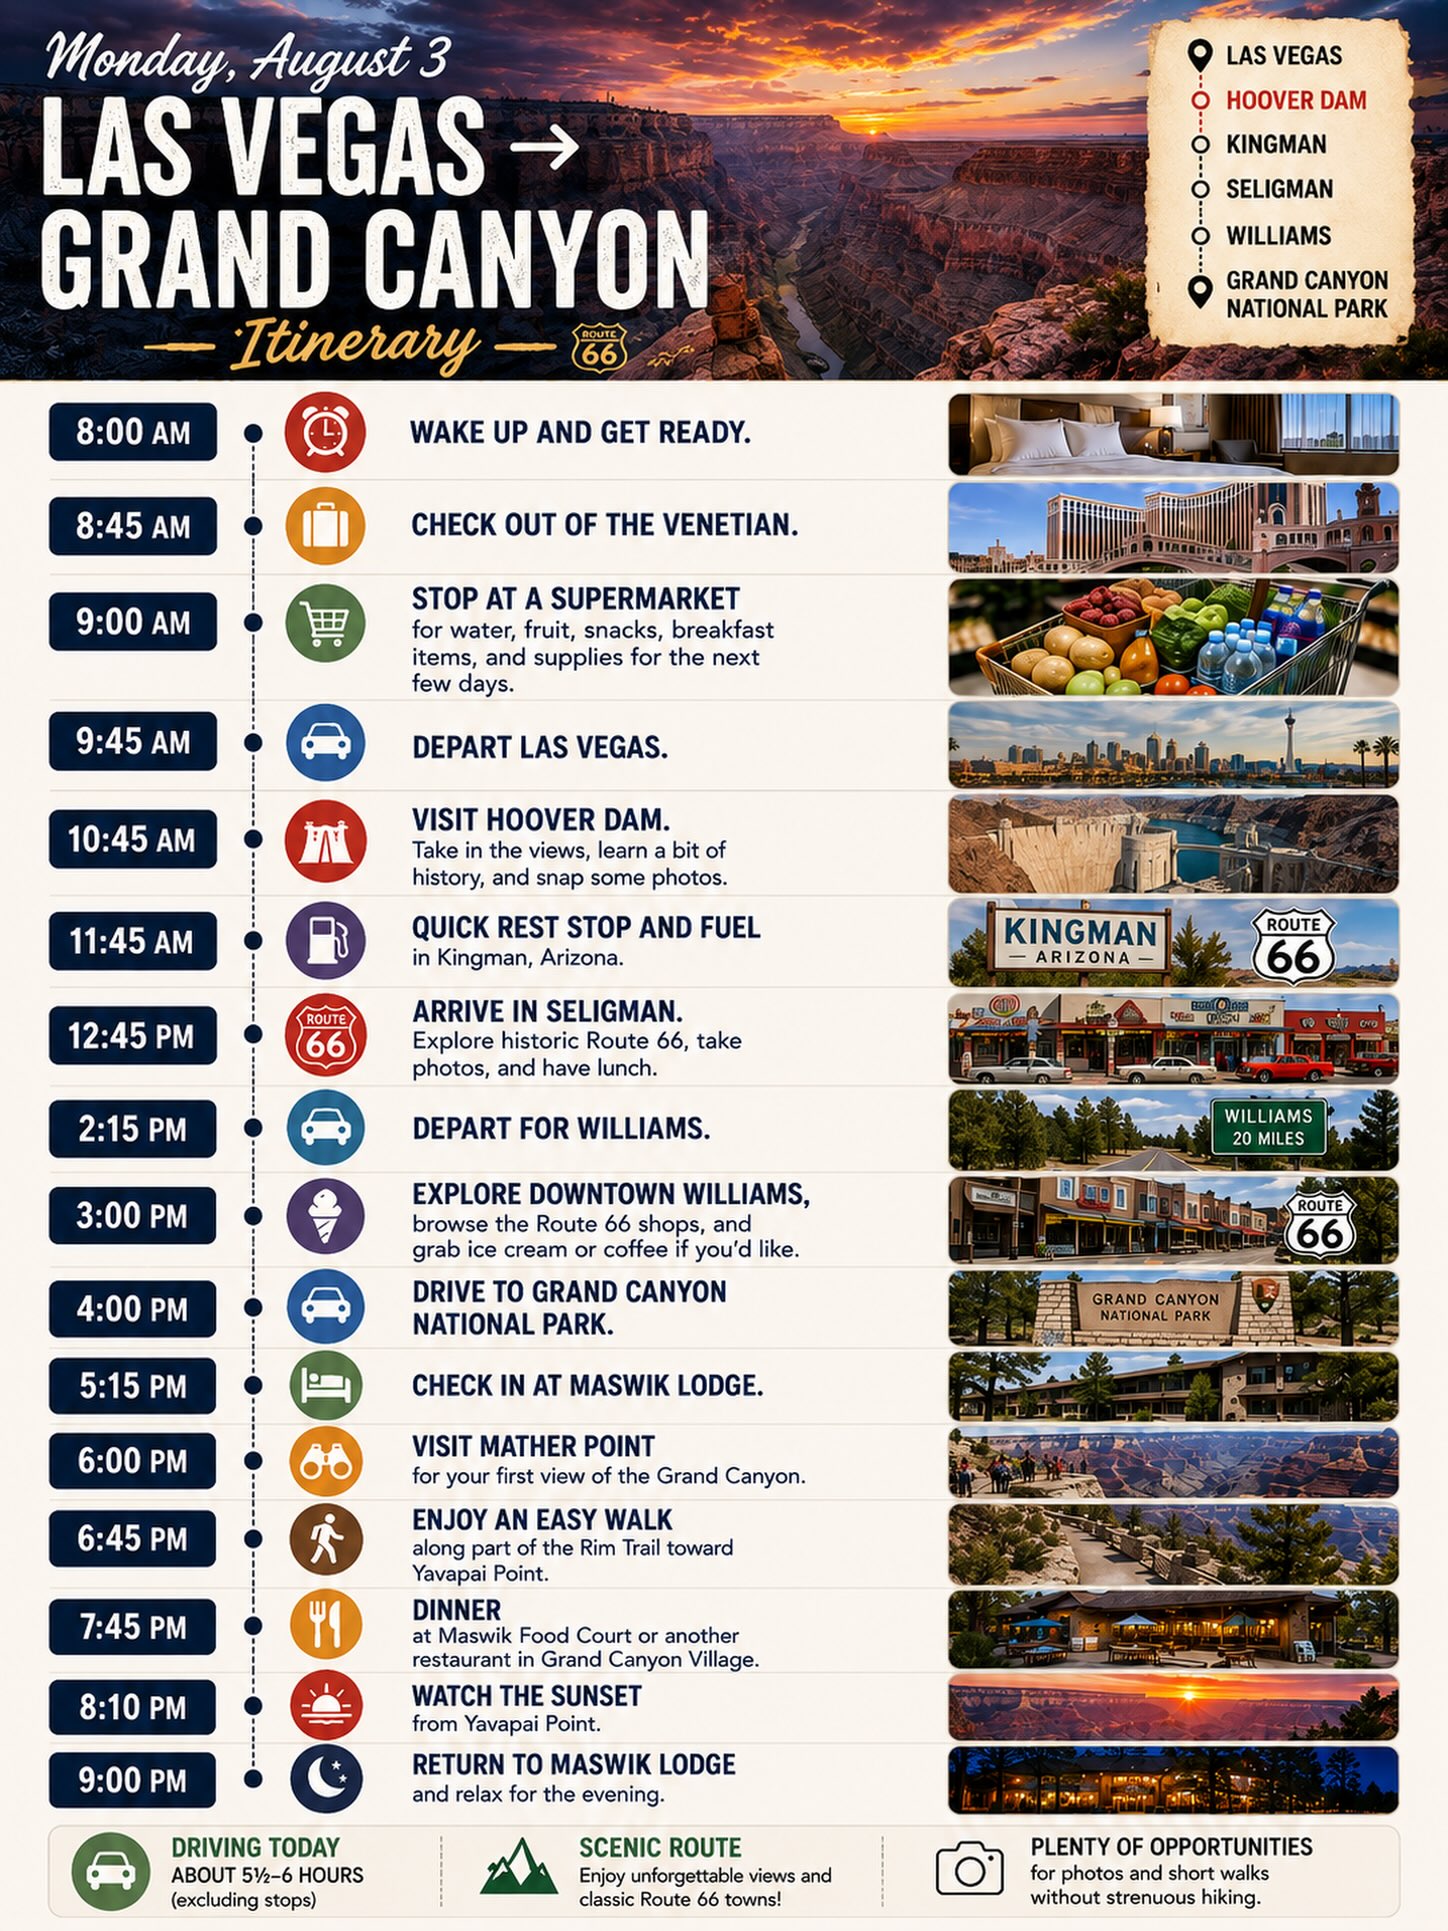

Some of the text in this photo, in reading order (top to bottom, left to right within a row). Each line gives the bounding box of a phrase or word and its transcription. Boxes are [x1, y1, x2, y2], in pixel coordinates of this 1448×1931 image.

[45, 29, 452, 94] Monday, August 3
[1227, 45, 1343, 66] LAS VEGAS
[1227, 89, 1367, 111] HOOVER DAM
[43, 95, 485, 197] LAS VEGAS
[1227, 133, 1327, 154] KINGMAN
[1226, 178, 1333, 199] SELIGMAN
[1226, 225, 1332, 246] WILLIAMS
[41, 208, 709, 311] GRAND CANYON
[1226, 270, 1389, 290] GRAND CANYON
[1227, 298, 1389, 319] NATIONAL PARK
[581, 330, 618, 339] ROUTE
[230, 316, 482, 378] Itinerary
[581, 342, 618, 366] 66
[76, 416, 190, 446] 8:00 AM
[409, 419, 751, 444] WAKE UP AND GET READY.
[411, 511, 798, 537] CHECK OUT OF THE VENETIAN.
[412, 586, 741, 611] STOP AT A SUPERMARKET
[76, 606, 190, 636] 9:00 AM
[411, 618, 775, 642] for water, fruit, snacks, breakfast
[411, 672, 514, 698] few days.
[412, 807, 670, 832] VISIT HOOVER DAM.
[68, 824, 195, 853] 10:45 AM
[413, 867, 728, 891] history, and snap some photos.
[412, 915, 761, 942] QUICK REST STOP AND FUEL
[1004, 917, 1157, 947] KINGMAN
[1267, 917, 1321, 932] ROUTE
[413, 947, 624, 971] in Kingman, Arizona.
[1035, 950, 1130, 965] ARIZONA
[1266, 937, 1322, 975] 66
[306, 1013, 347, 1025] ROUTE
[412, 999, 683, 1023] ARRIVE IN SELIGMAN.
[68, 1021, 194, 1050] 12:45 PM
[305, 1030, 346, 1059] 66
[413, 1030, 742, 1053] Explore historic Route 66, take
[1224, 1108, 1313, 1124] WILLIAMS
[1232, 1130, 1305, 1146] 20 MILES
[413, 1182, 810, 1209] EXPLORE DOWNTOWN WILLIAMS,
[1297, 1199, 1343, 1212] ROUTE
[76, 1200, 187, 1229] 3:00 PM
[1296, 1217, 1344, 1251] 66
[412, 1239, 461, 1263] grab
[468, 1239, 497, 1258] ice
[504, 1244, 568, 1258] cream
[574, 1244, 597, 1258] or
[603, 1238, 669, 1258] coffee
[675, 1238, 690, 1258] if
[759, 1238, 799, 1258] like.
[1092, 1292, 1219, 1306] GRAND CANYON
[1100, 1309, 1211, 1322] NATIONAL PARK
[80, 1371, 187, 1399] 5:15 PM
[412, 1373, 764, 1397] CHECK IN AT MASWIK LODGE.
[78, 1446, 187, 1474] 6:00 PM
[412, 1564, 549, 1587] Yavapai Point.
[413, 1598, 501, 1621] DINNER
[80, 1612, 186, 1640] 7:45 PM
[412, 1626, 740, 1644] at Maswik Food Court or another
[79, 1692, 186, 1721] 8:10 PM
[412, 1713, 601, 1737] from Yavapai Point.
[413, 1752, 736, 1776] RETURN TO MASWIK LODGE
[78, 1765, 186, 1794] 9:00 PM
[172, 1836, 341, 1858] DRIVING TODAY
[1031, 1836, 1313, 1857] PLENTY OF OPPORTUNITIES
[171, 1866, 237, 1884] ABOUT
[299, 1866, 364, 1884] HOURS
[579, 1866, 832, 1888] Enjoy unforgettable views and
[171, 1891, 317, 1912] (excluding stops)
[1030, 1888, 1261, 1910] without strenuous hiking.
